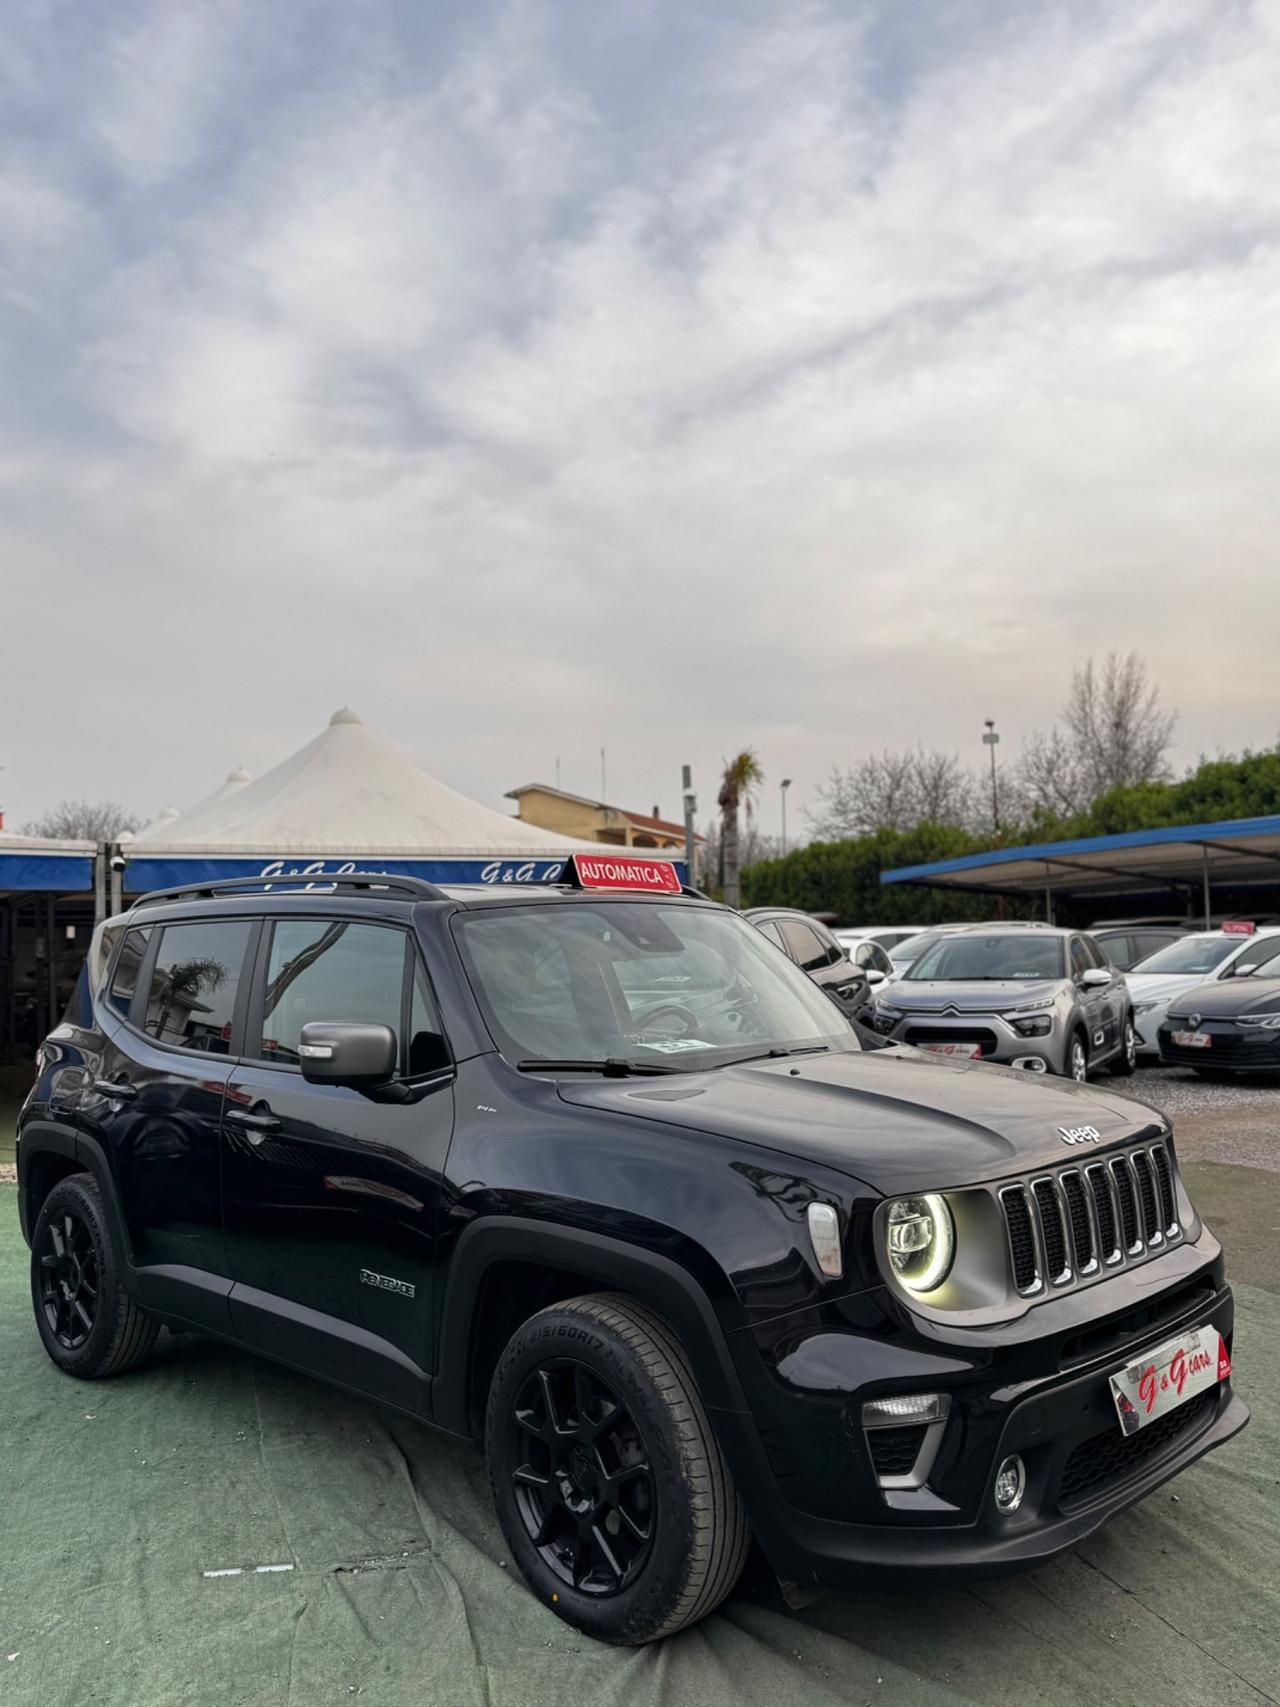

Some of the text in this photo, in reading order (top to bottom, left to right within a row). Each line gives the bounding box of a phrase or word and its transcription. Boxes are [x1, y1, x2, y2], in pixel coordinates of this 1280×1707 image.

[581, 862, 664, 884] AUTOMATICA
[1057, 1125, 1100, 1145] Jeep
[360, 1268, 416, 1298] RENEGADE
